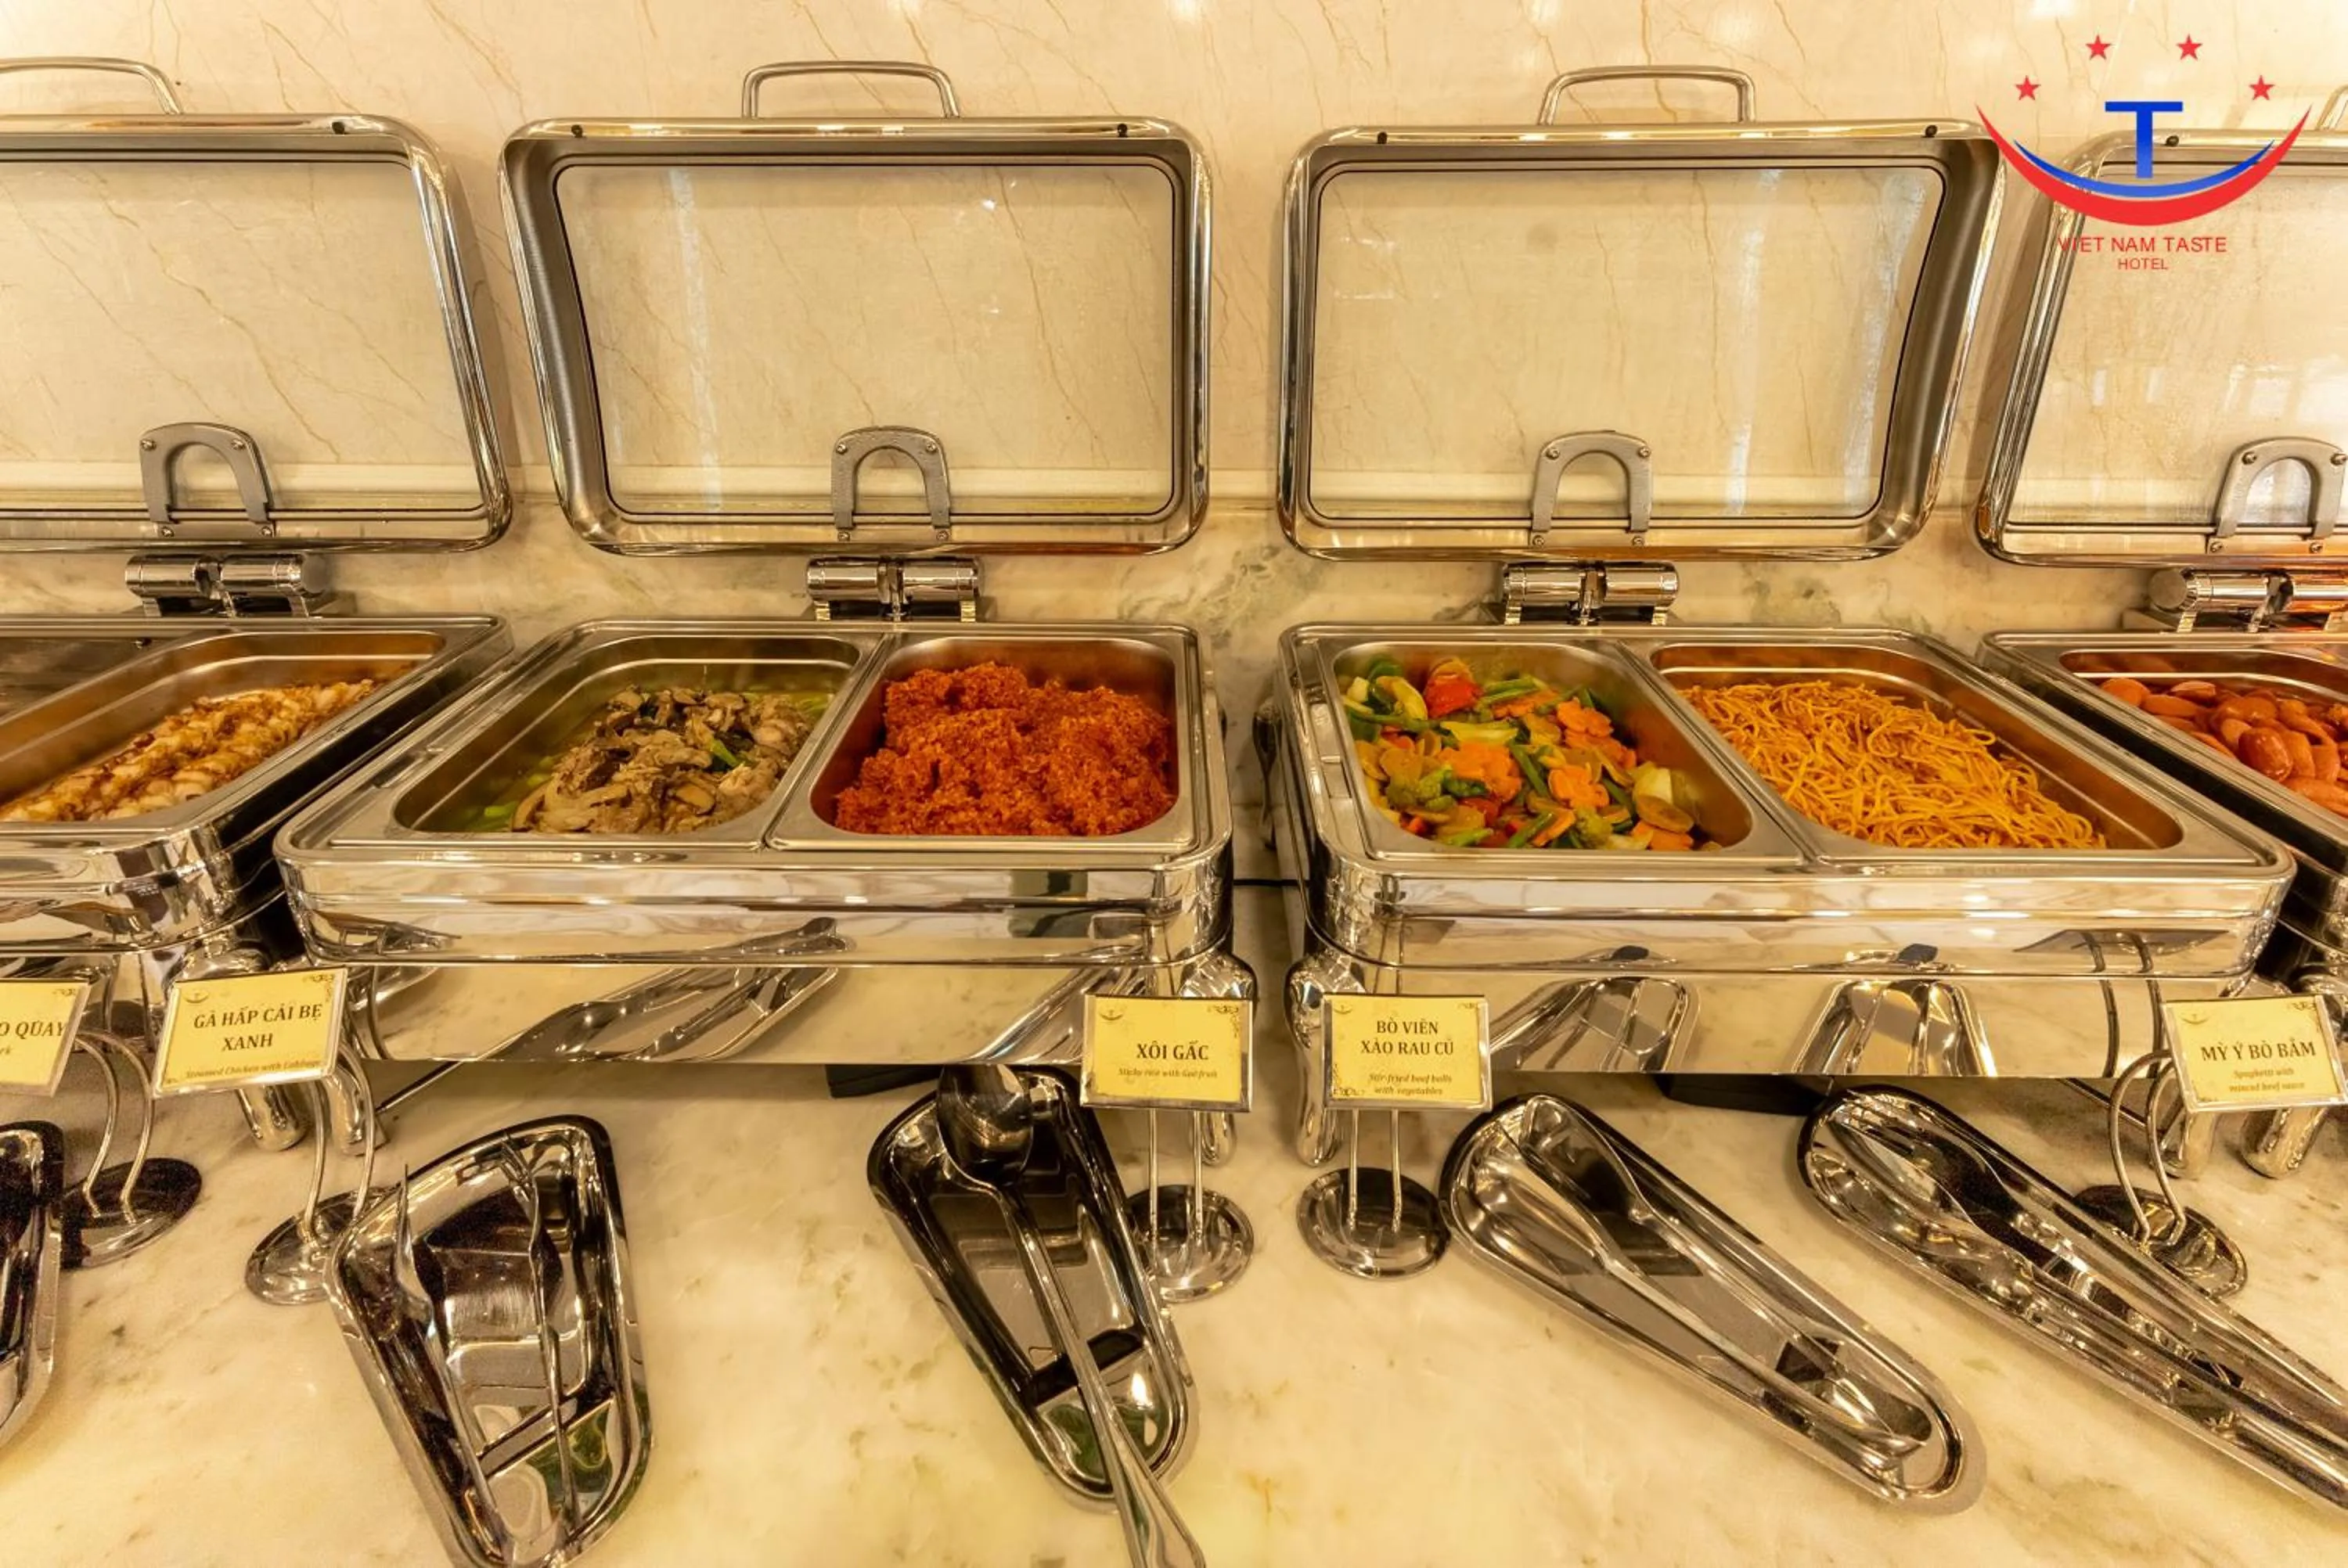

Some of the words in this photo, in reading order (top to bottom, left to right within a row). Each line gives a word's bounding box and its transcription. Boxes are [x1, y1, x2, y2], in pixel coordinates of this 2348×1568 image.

[221, 1005, 258, 1027] HẤP
[1377, 1017, 1398, 1034] BÒ
[221, 1033, 274, 1052] XANH
[1136, 1040, 1167, 1059] XÔI
[1399, 1041, 1430, 1055] RAU
[2248, 1040, 2273, 1059] BÒ
[261, 1062, 282, 1071] with
[1162, 1069, 1179, 1077] with
[1374, 1085, 1395, 1094] with
